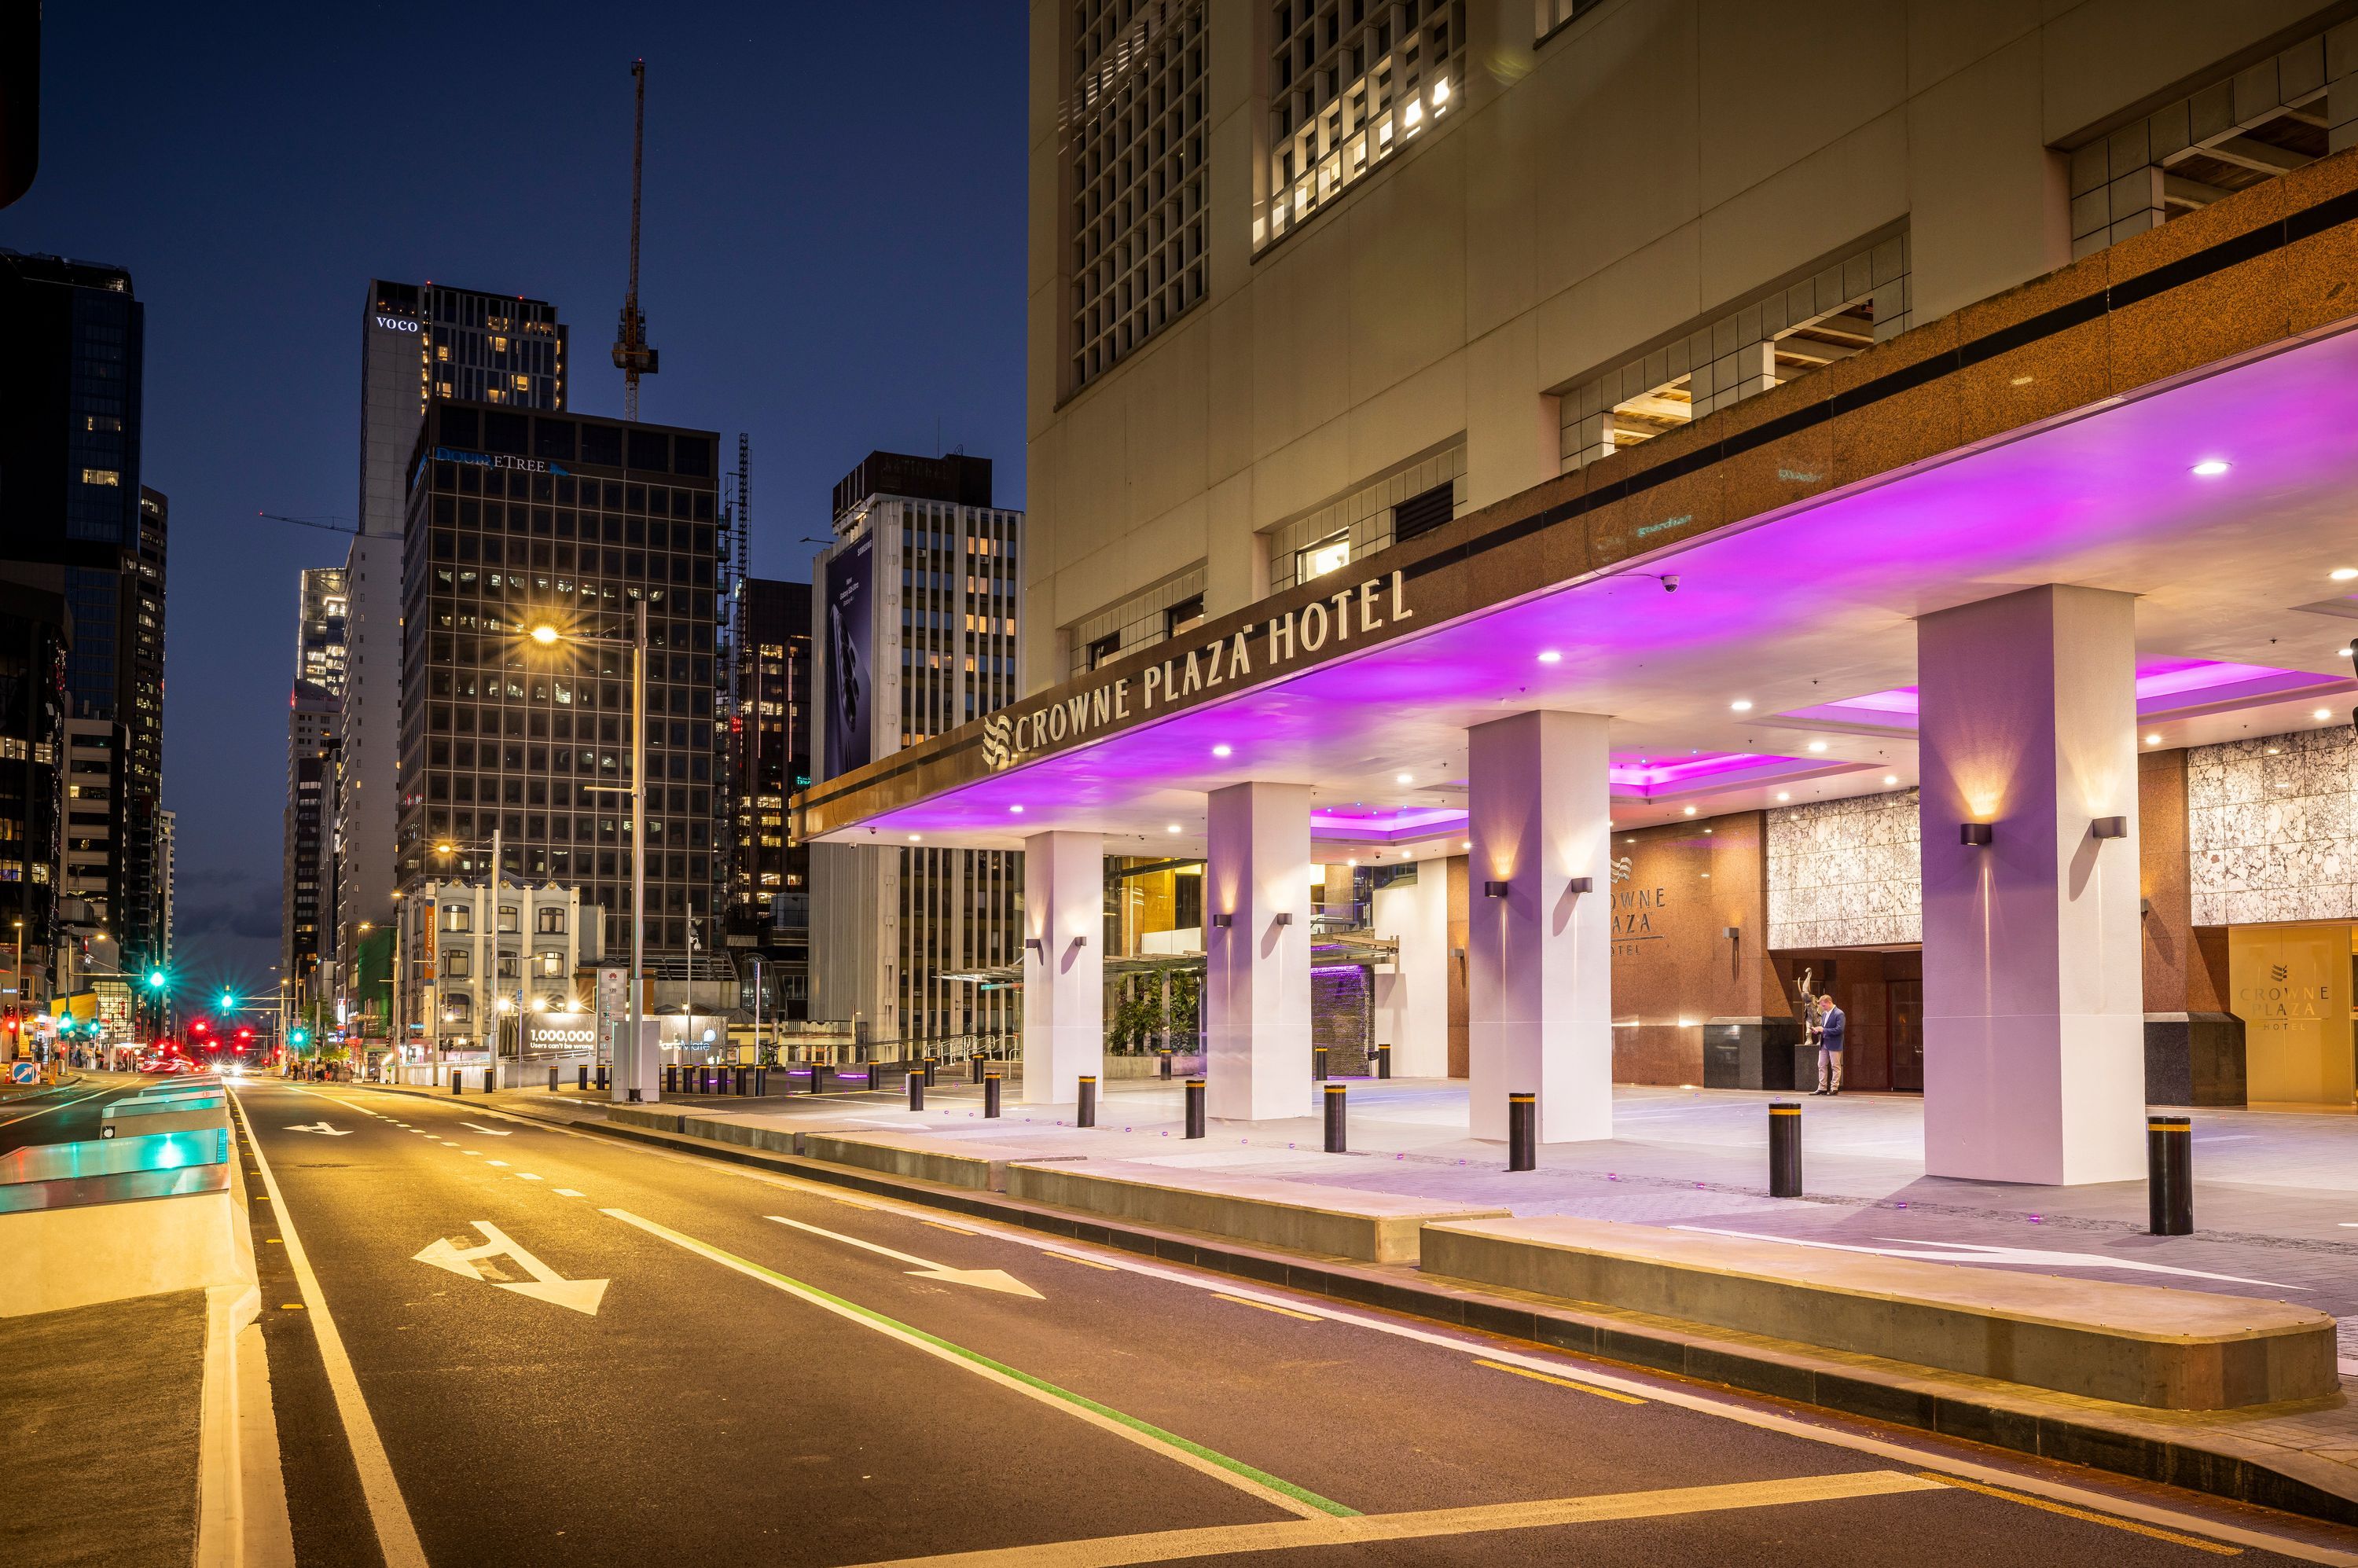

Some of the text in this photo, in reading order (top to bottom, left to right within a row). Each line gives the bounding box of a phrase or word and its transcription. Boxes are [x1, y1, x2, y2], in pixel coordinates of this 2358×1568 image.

[857, 539, 872, 556] SAMSUNG
[1016, 678, 1130, 752] CROWNE
[1144, 632, 1251, 709] PLAZA
[1269, 570, 1413, 665] HOTEL
[1611, 888, 1666, 912] OWNE
[1612, 913, 1651, 935] AZA
[1611, 945, 1641, 957] OTEL
[2240, 986, 2329, 1001] CROWNE
[2251, 1002, 2315, 1016] PLAZA
[2263, 1023, 2306, 1031] HOTEL
[530, 1030, 594, 1042] 1,000,000
